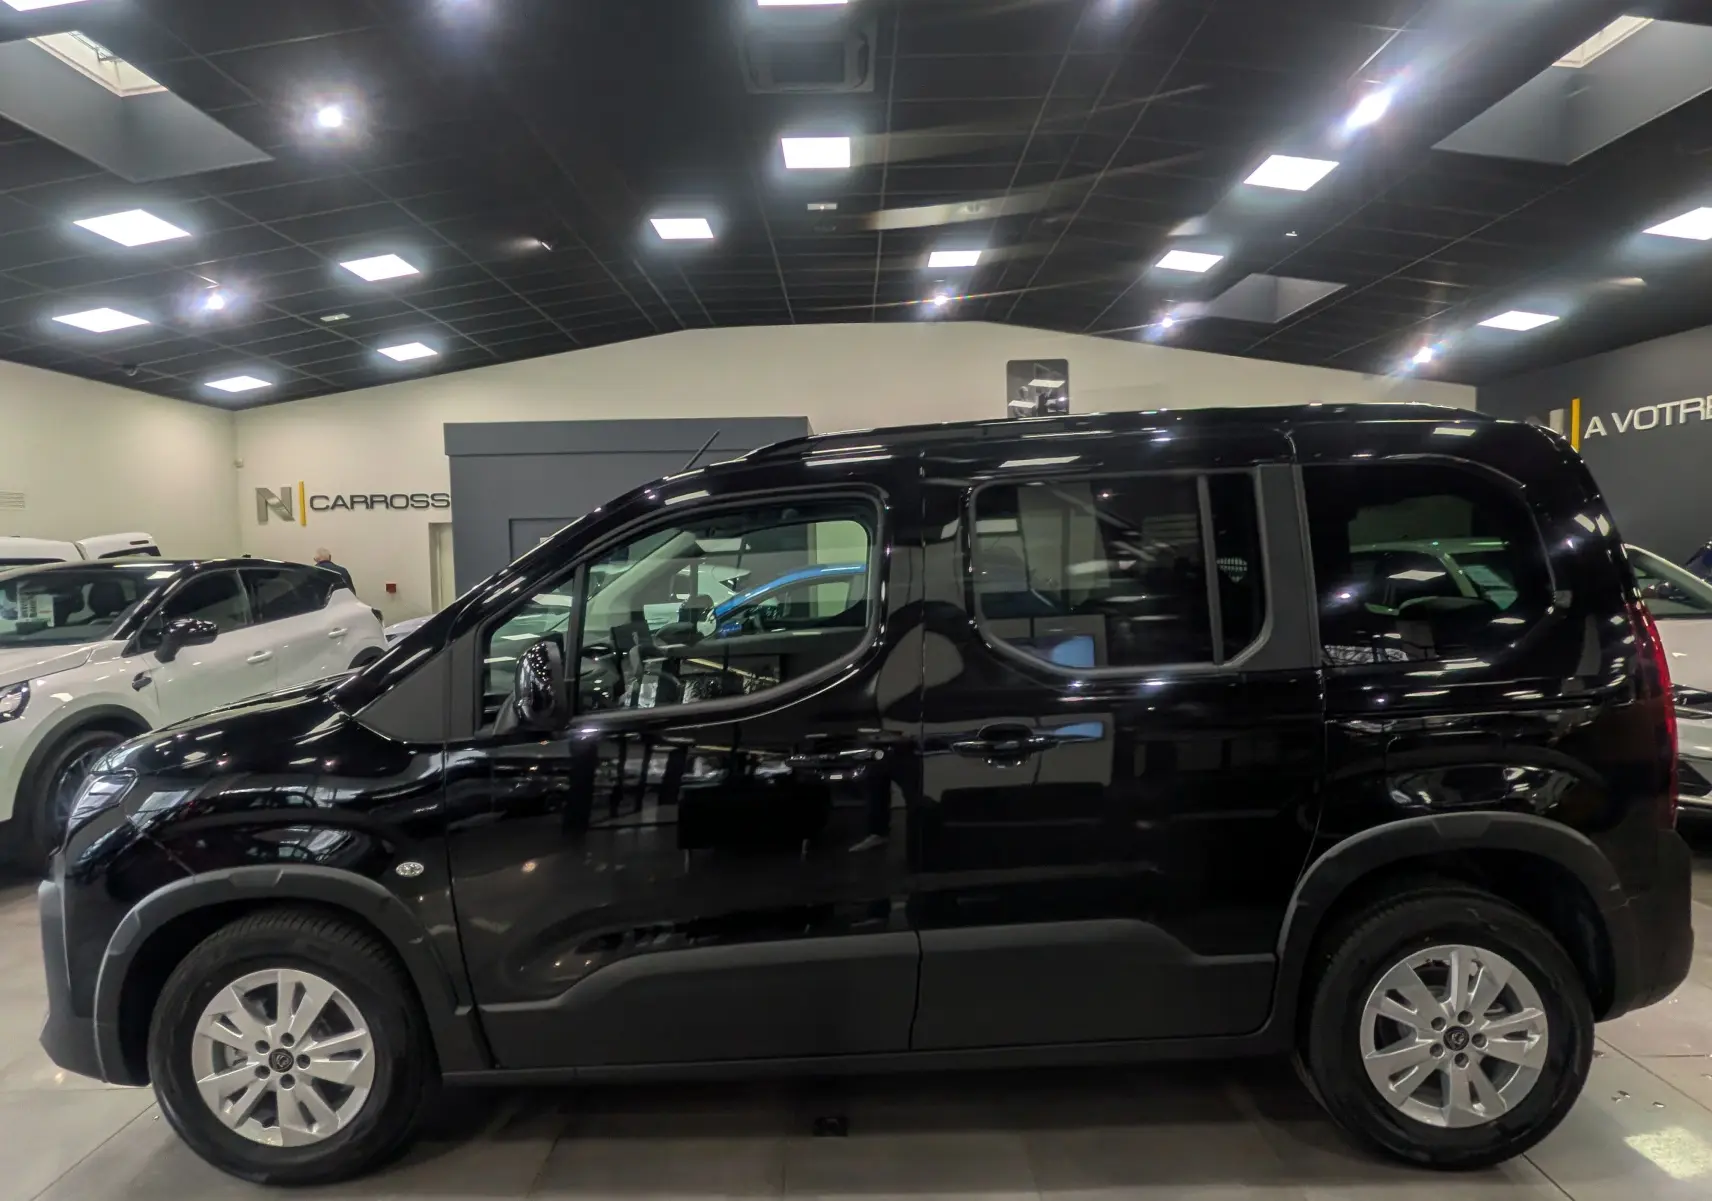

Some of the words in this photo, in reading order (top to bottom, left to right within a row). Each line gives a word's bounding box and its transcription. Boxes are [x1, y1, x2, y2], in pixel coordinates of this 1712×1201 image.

[1584, 416, 1607, 439] A
[1611, 394, 1712, 433] VOTR
[255, 487, 295, 524] N
[309, 493, 451, 511] CARROSS
